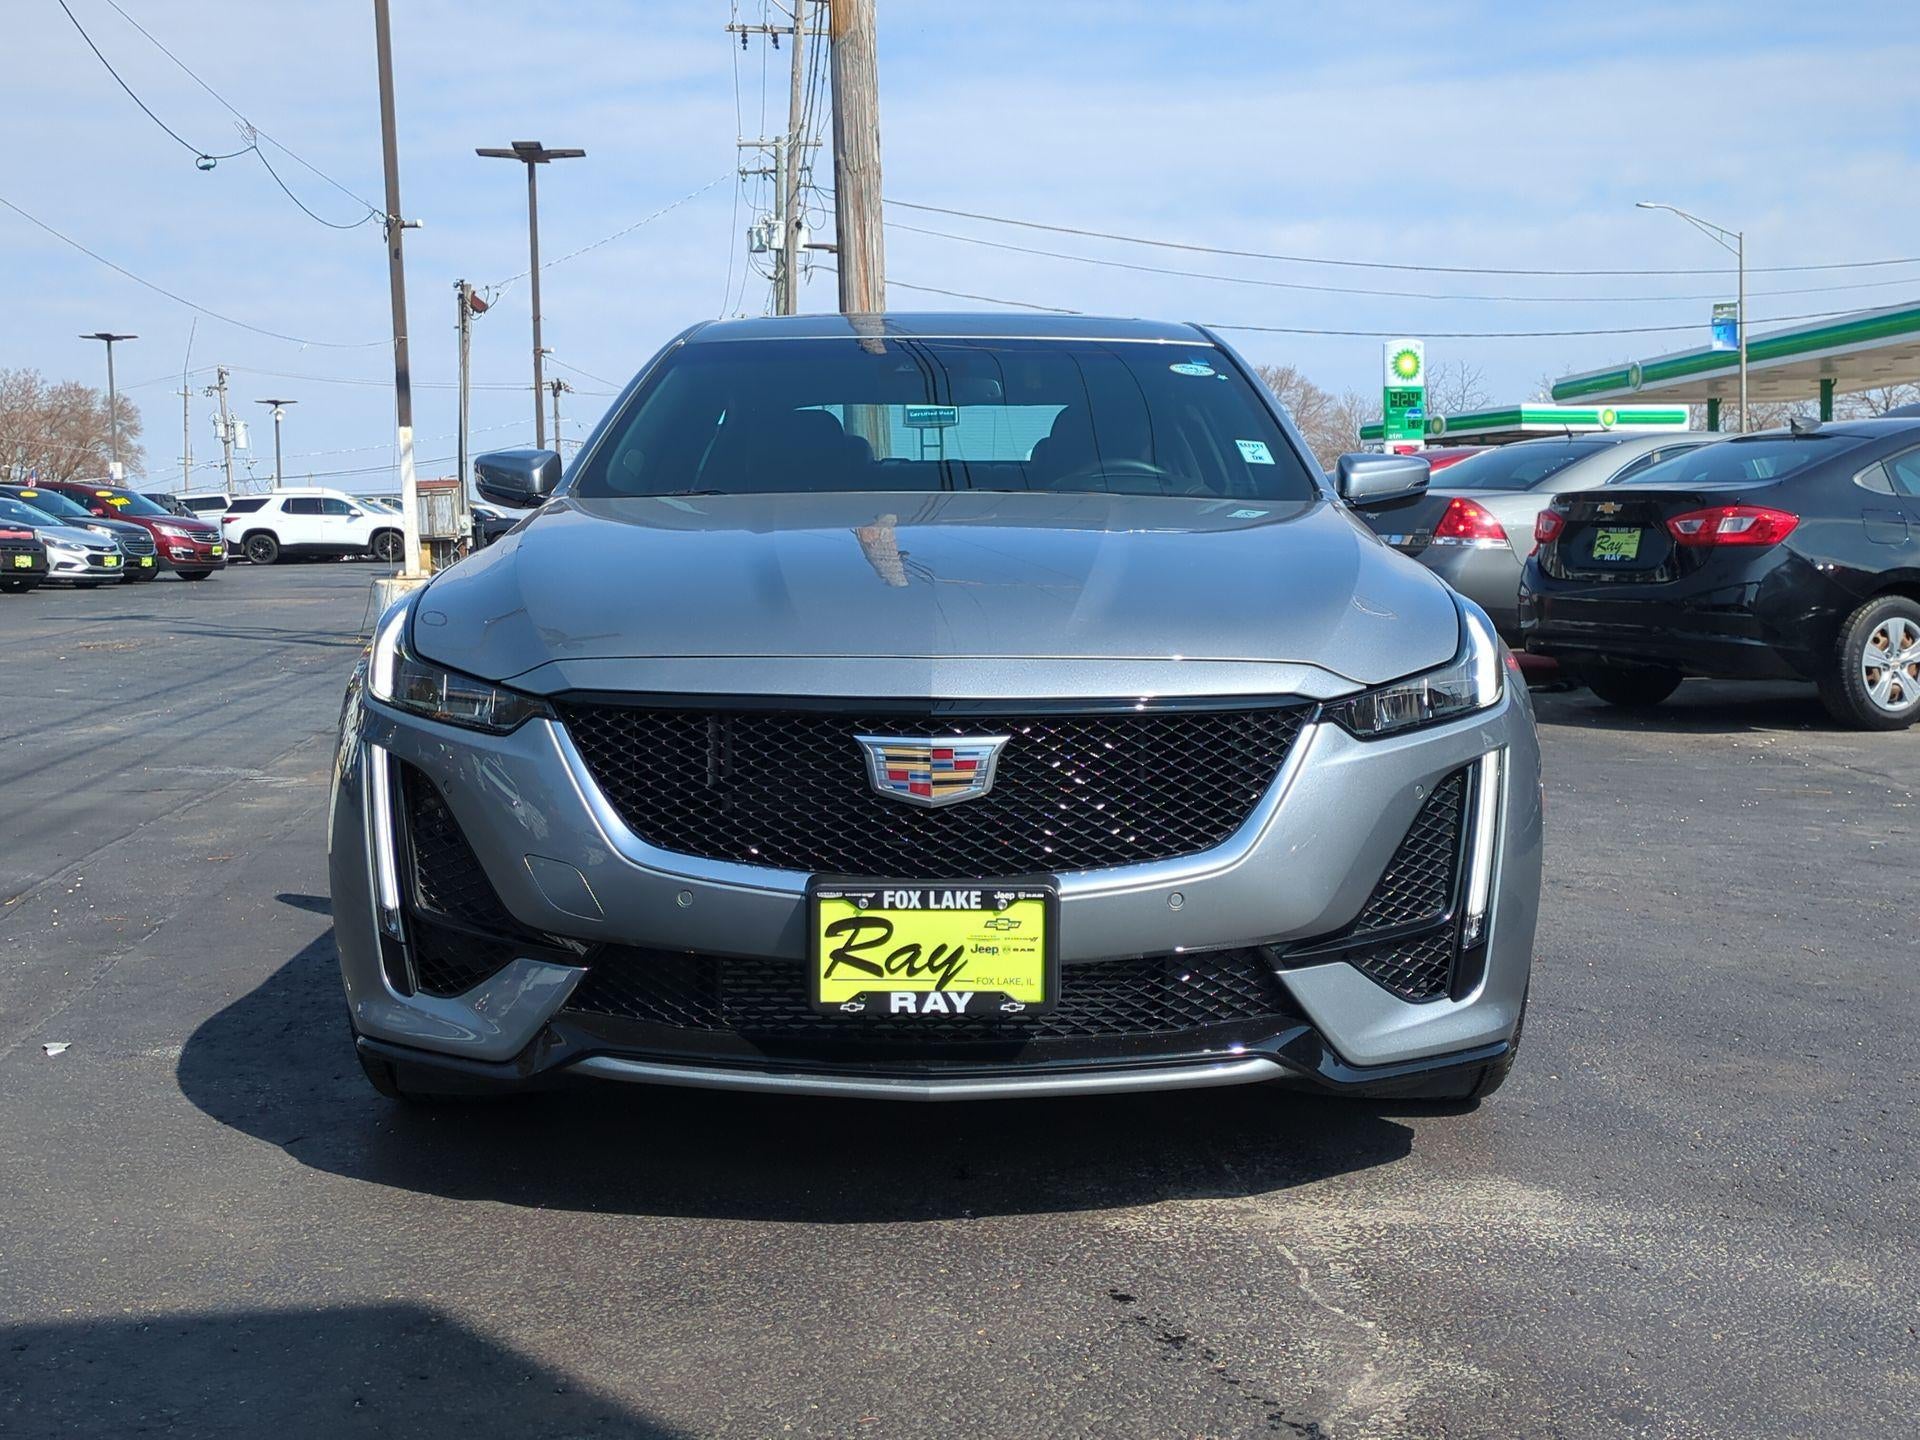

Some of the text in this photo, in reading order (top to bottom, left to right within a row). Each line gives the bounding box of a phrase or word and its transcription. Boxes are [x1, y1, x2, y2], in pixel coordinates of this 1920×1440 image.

[1595, 534, 1623, 555] Ray
[883, 891, 982, 909] FOX LAKE
[994, 891, 1015, 900] Jeep
[824, 916, 968, 991] Ray
[970, 944, 999, 955] Jeep
[976, 976, 995, 986] FOX
[997, 976, 1023, 987] LAKE,
[890, 992, 973, 1014] RAY
